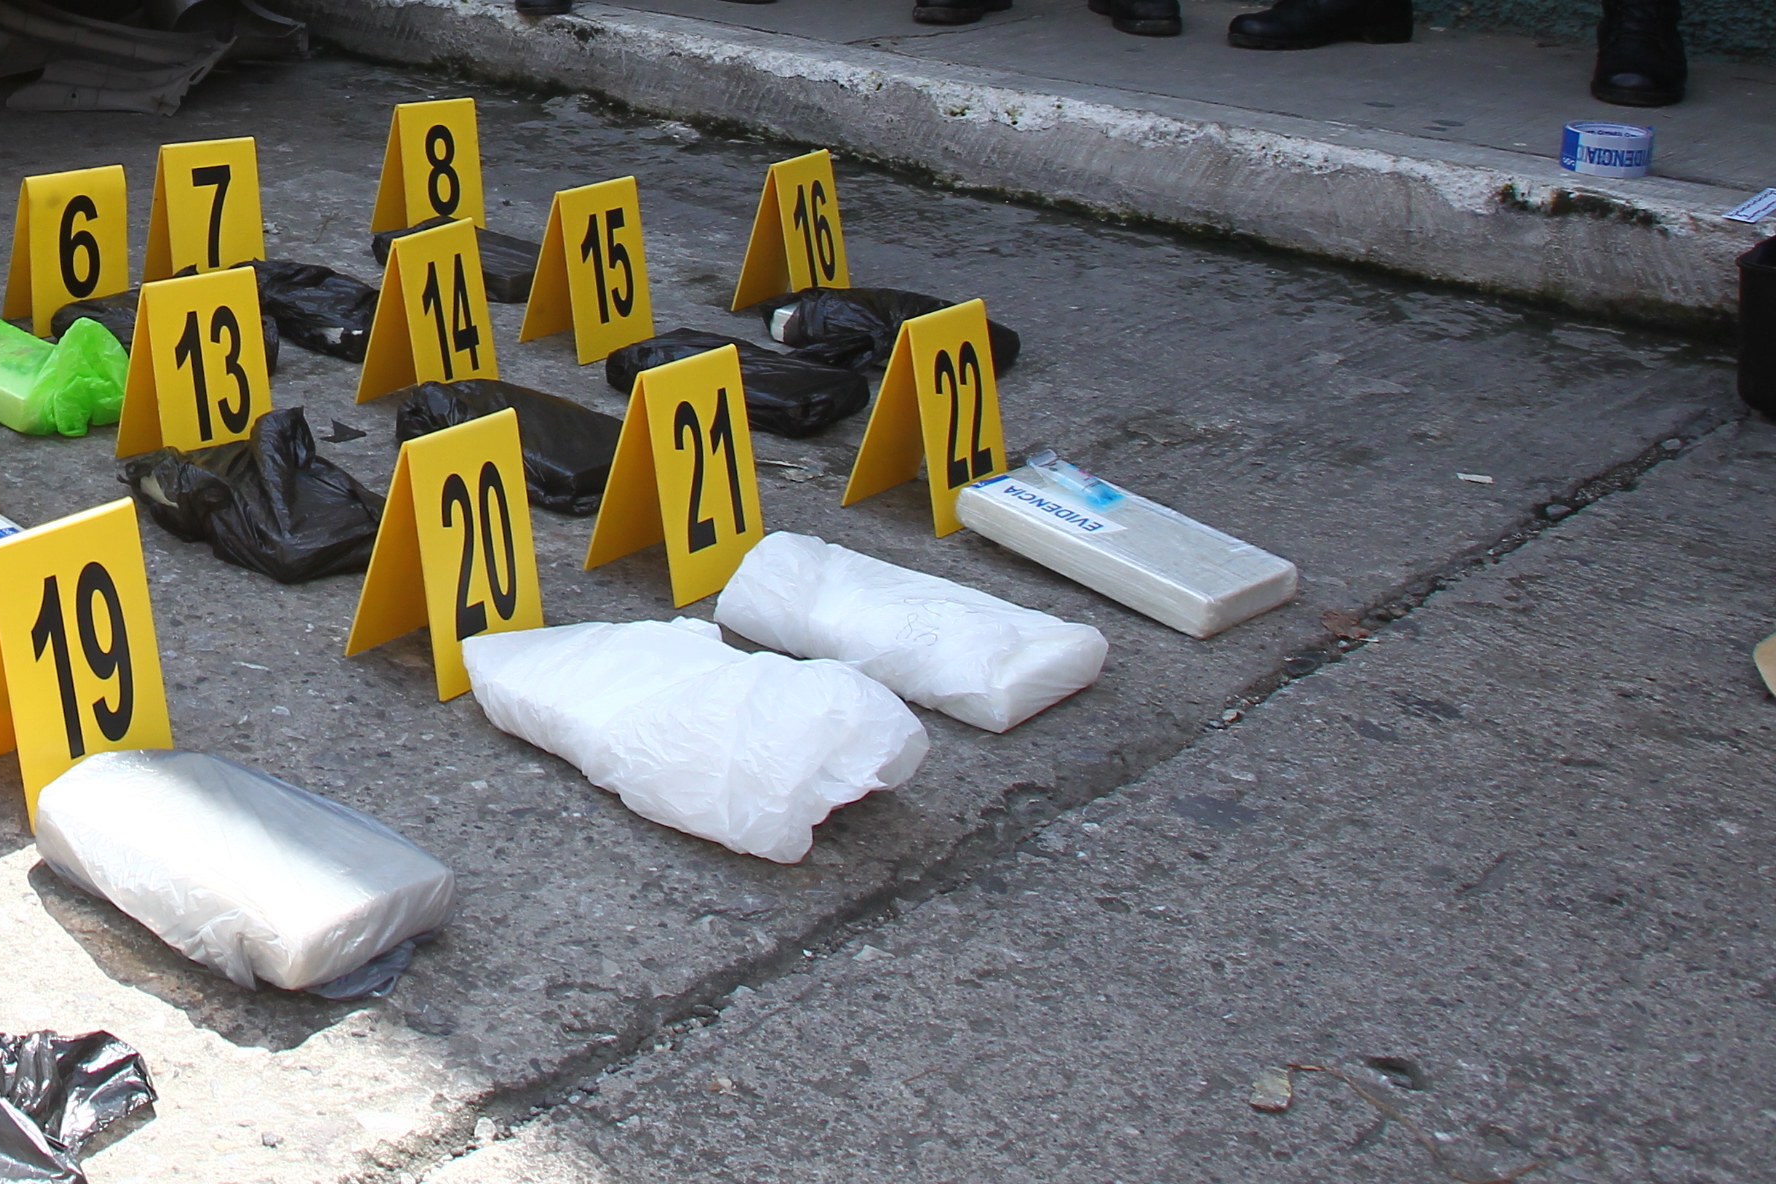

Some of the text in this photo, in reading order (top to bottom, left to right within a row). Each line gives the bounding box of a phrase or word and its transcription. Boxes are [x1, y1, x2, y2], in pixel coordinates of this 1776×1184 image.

[191, 164, 232, 268] 7
[426, 125, 460, 215] 8
[58, 195, 101, 298] 6
[580, 206, 634, 324] 15
[793, 179, 836, 289] 16
[174, 305, 251, 443] 13
[422, 253, 480, 381] 14
[673, 388, 746, 554] 21
[935, 341, 993, 489] 22
[441, 461, 517, 641] 20
[1003, 485, 1105, 532] EVIDENCIA
[31, 562, 133, 759] 19
